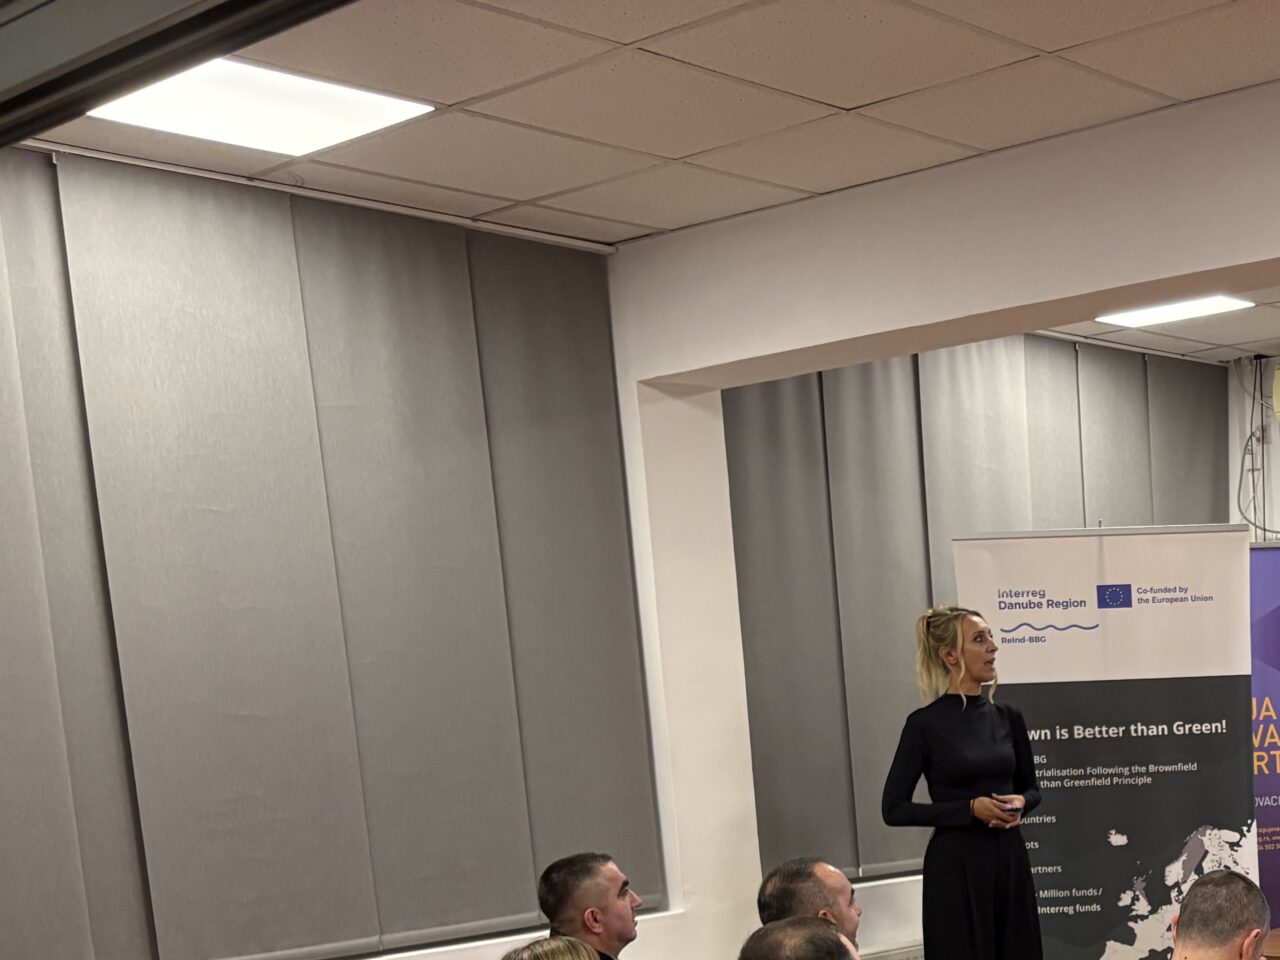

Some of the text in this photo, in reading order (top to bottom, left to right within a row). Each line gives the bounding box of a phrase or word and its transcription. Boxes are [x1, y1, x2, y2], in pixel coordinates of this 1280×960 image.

[998, 588, 1046, 600] Interreg
[1136, 585, 1189, 595] Co-funded by
[999, 598, 1086, 611] Danube Region
[1137, 594, 1214, 605] the European Union
[1055, 725, 1069, 740] is
[1073, 723, 1126, 739] Better
[1129, 722, 1169, 737] than
[1172, 719, 1227, 735] Green!
[1086, 765, 1130, 777] Following
[1131, 765, 1147, 774] the
[1148, 762, 1198, 773] Brownfield
[1040, 775, 1152, 788] than Greenfield Principle
[1039, 888, 1071, 899] Million
[1072, 887, 1097, 897] funds
[1037, 903, 1101, 915] Interreg funds
